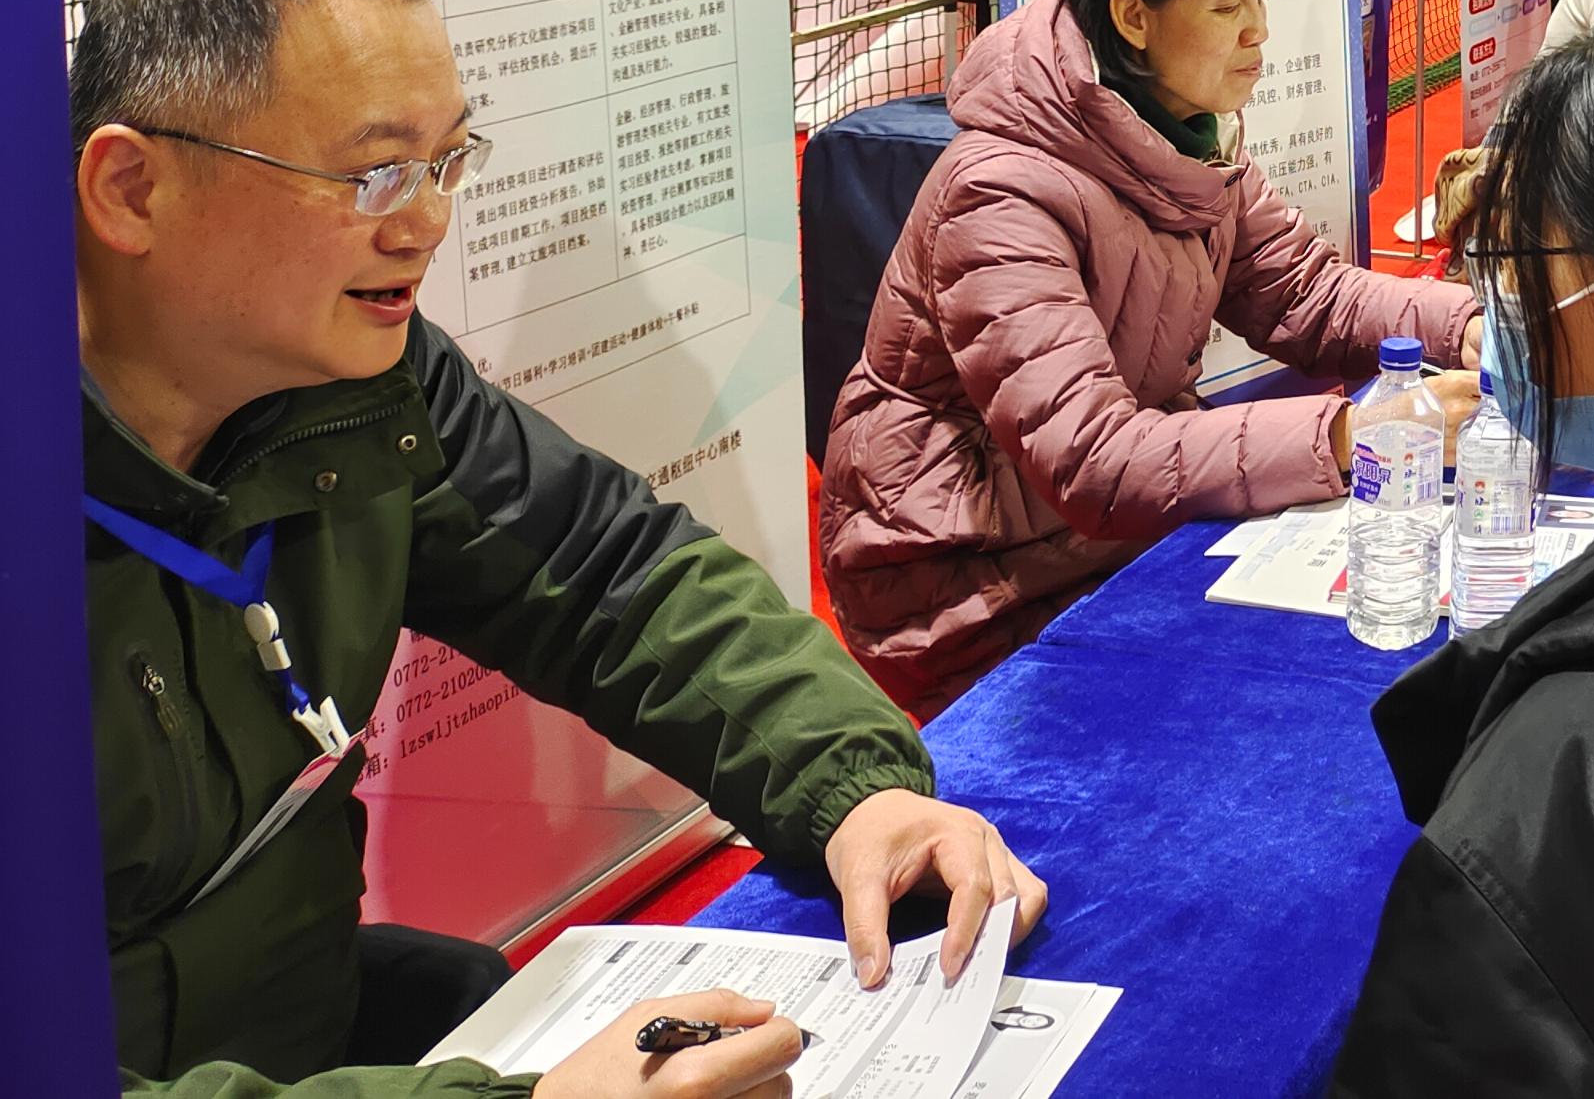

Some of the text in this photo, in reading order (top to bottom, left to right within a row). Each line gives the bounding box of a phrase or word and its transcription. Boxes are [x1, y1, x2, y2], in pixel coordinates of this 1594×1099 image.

[1245, 126, 1333, 157] 绩优秀，具有良好的
[394, 646, 461, 687] 0772-21
